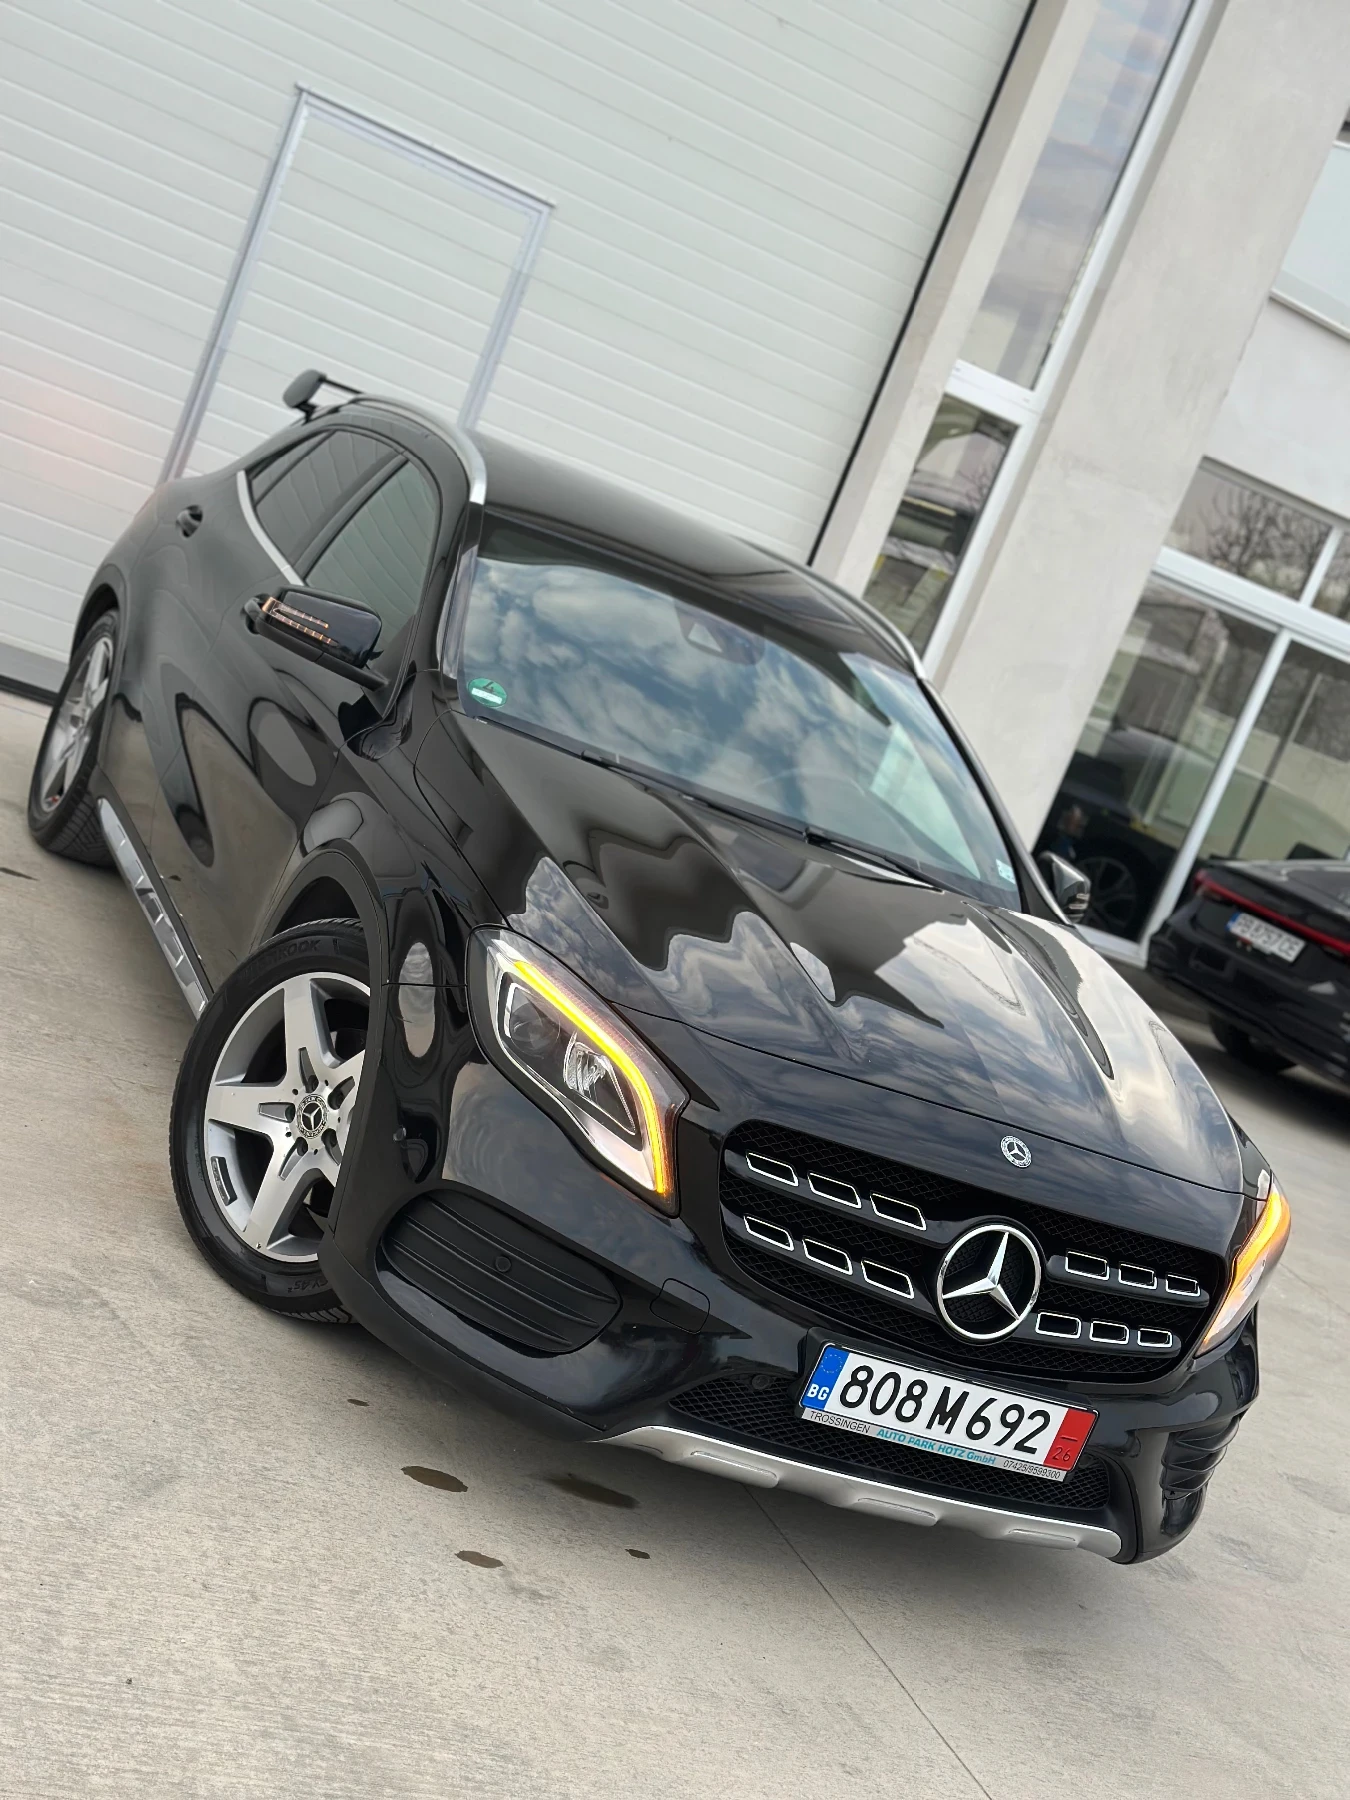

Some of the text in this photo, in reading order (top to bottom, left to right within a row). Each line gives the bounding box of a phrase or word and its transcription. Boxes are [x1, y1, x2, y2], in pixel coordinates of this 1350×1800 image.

[807, 1383, 830, 1400] BG
[840, 1365, 1051, 1455] 808 M 692
[809, 1410, 1061, 1480] TROSSINGEN AUTO PARK HOTZ GmbH 07425/9599300
[1052, 1446, 1071, 1462] 26
